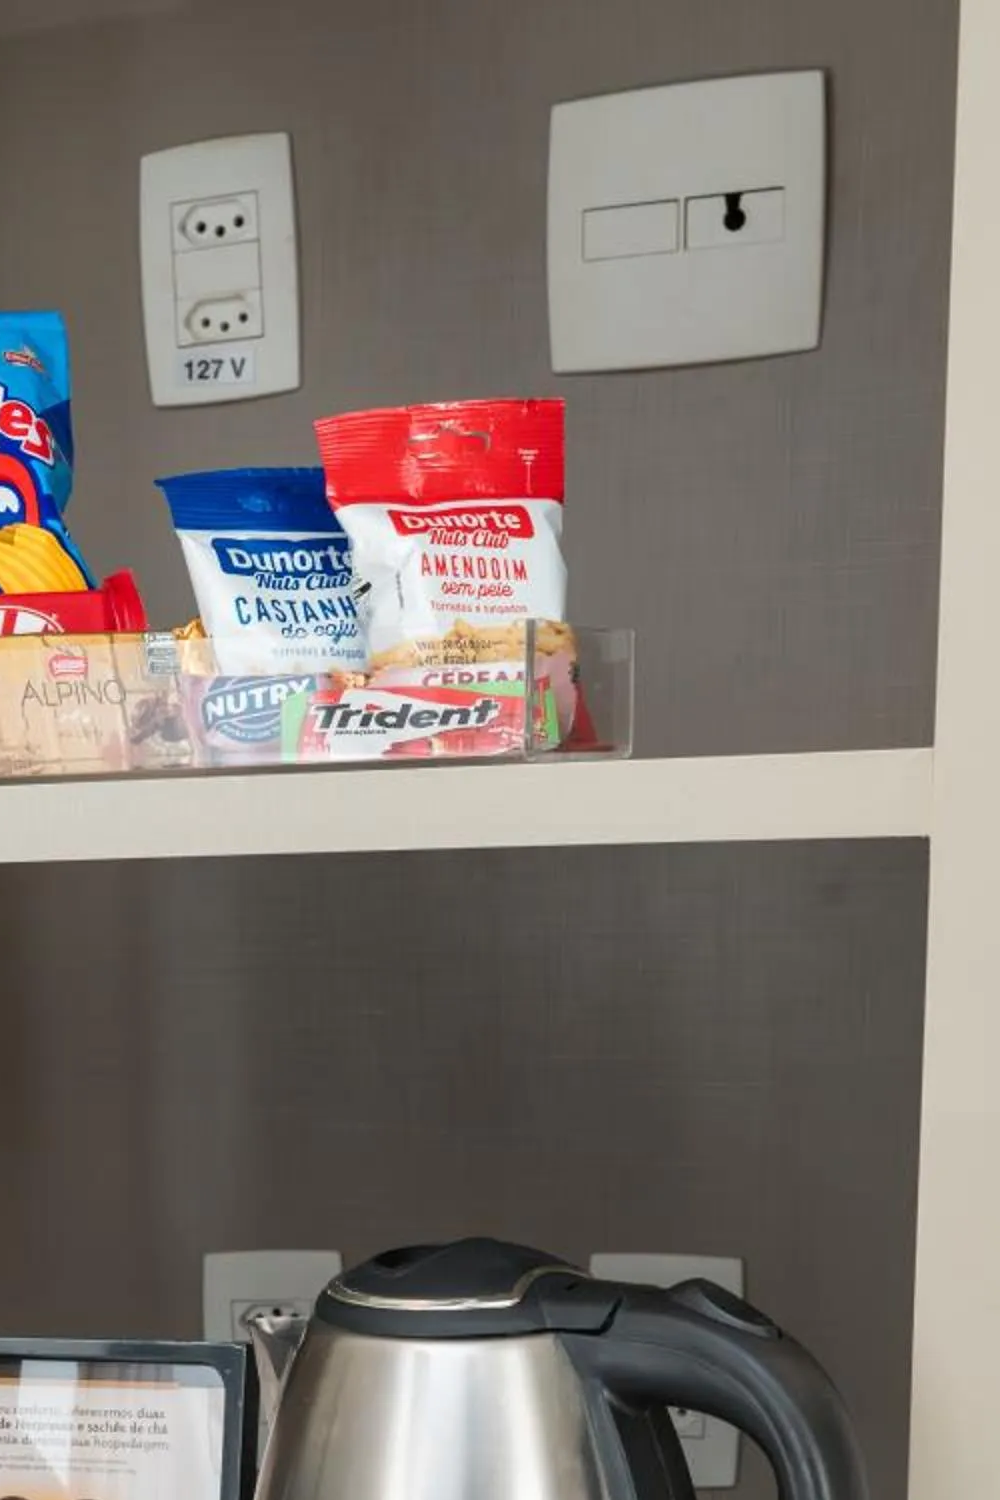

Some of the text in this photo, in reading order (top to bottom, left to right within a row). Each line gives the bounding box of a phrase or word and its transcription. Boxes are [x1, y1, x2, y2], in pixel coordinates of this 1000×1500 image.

[184, 357, 247, 381] 127 V
[401, 510, 521, 529] Dunorte
[429, 529, 509, 549] Nuts Club
[421, 552, 528, 582] AMENDOIM
[255, 573, 350, 591] Nuts Club
[21, 680, 127, 706] ALPINO
[205, 678, 312, 724] NUTRY
[313, 698, 498, 730] Trident
